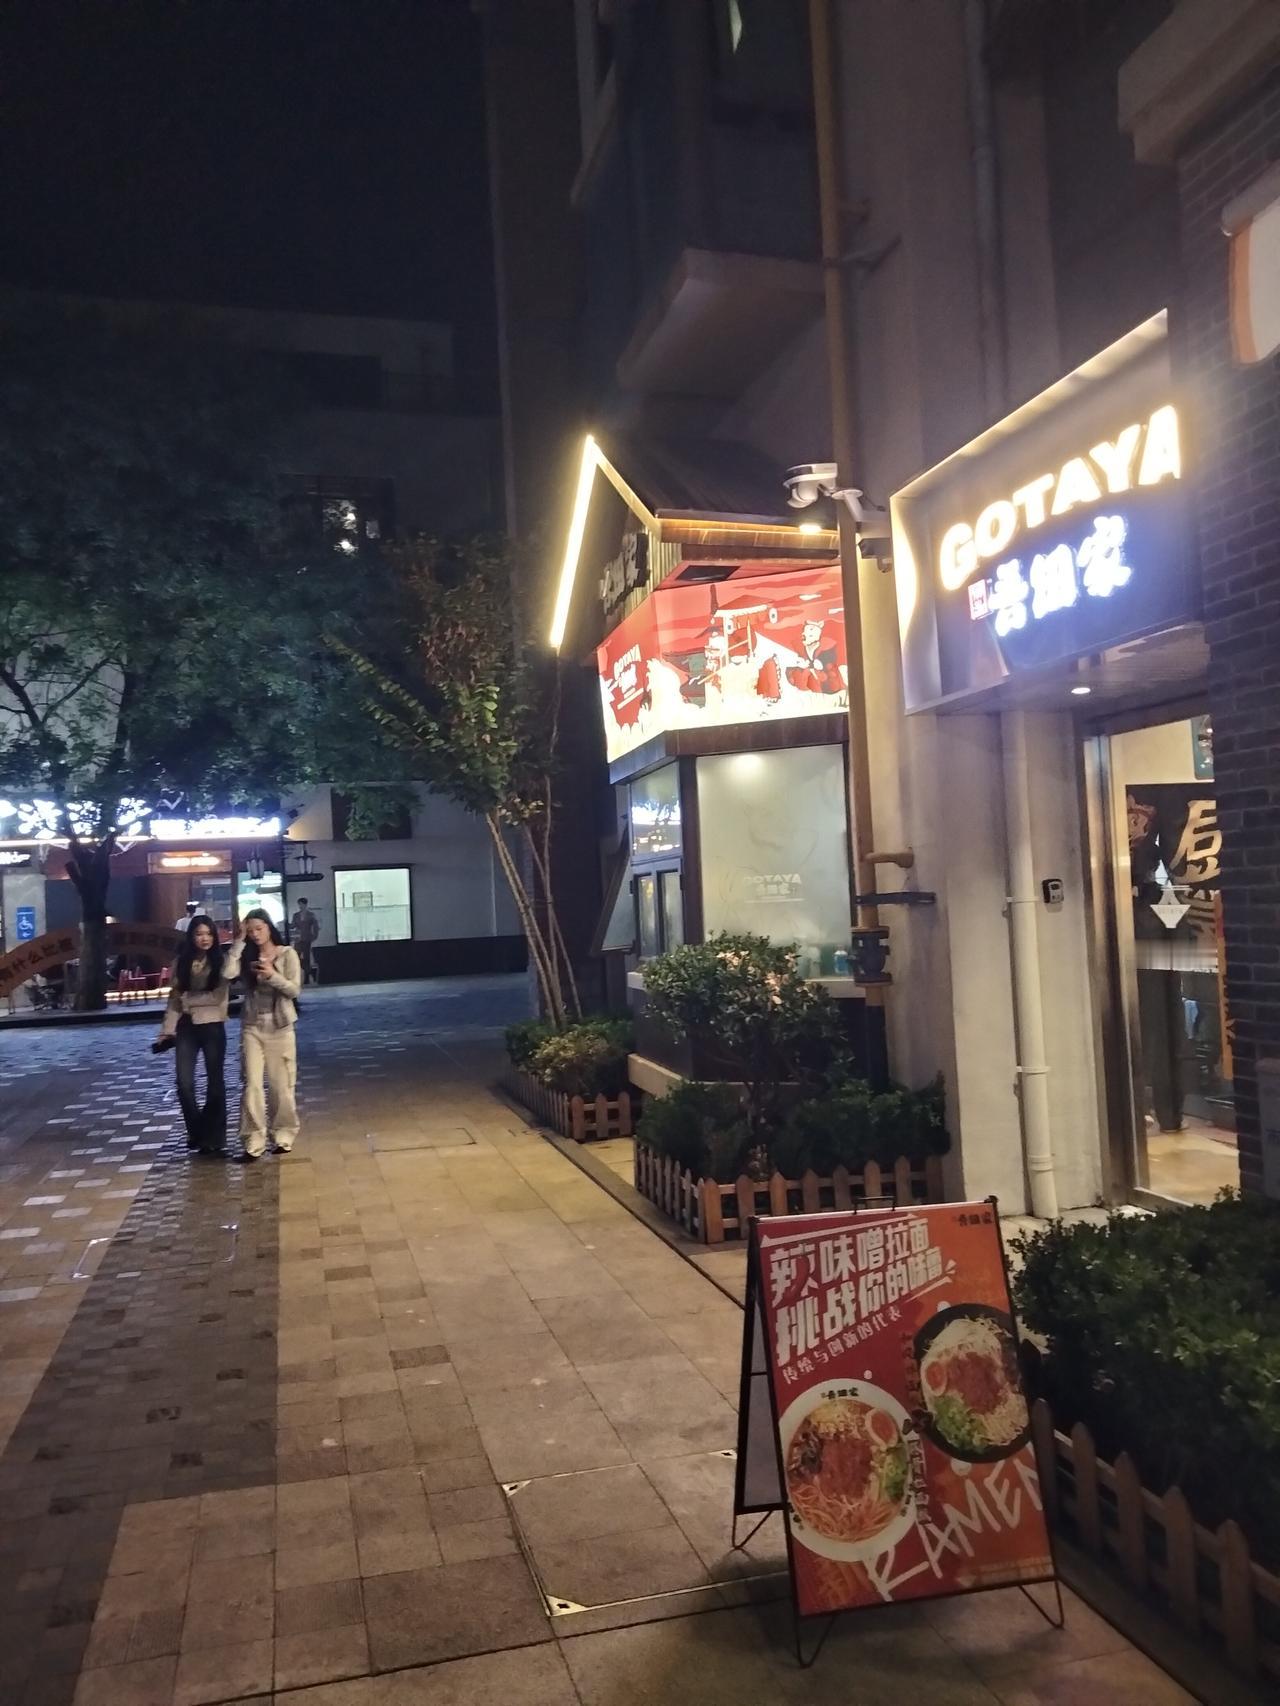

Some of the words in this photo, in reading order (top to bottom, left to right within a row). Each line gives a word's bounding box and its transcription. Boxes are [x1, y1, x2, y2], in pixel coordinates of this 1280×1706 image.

[940, 405, 1182, 590] GOTAYA
[770, 1218, 930, 1307] 辣味噌拉面
[776, 1246, 944, 1367] 挑战你的味蕾
